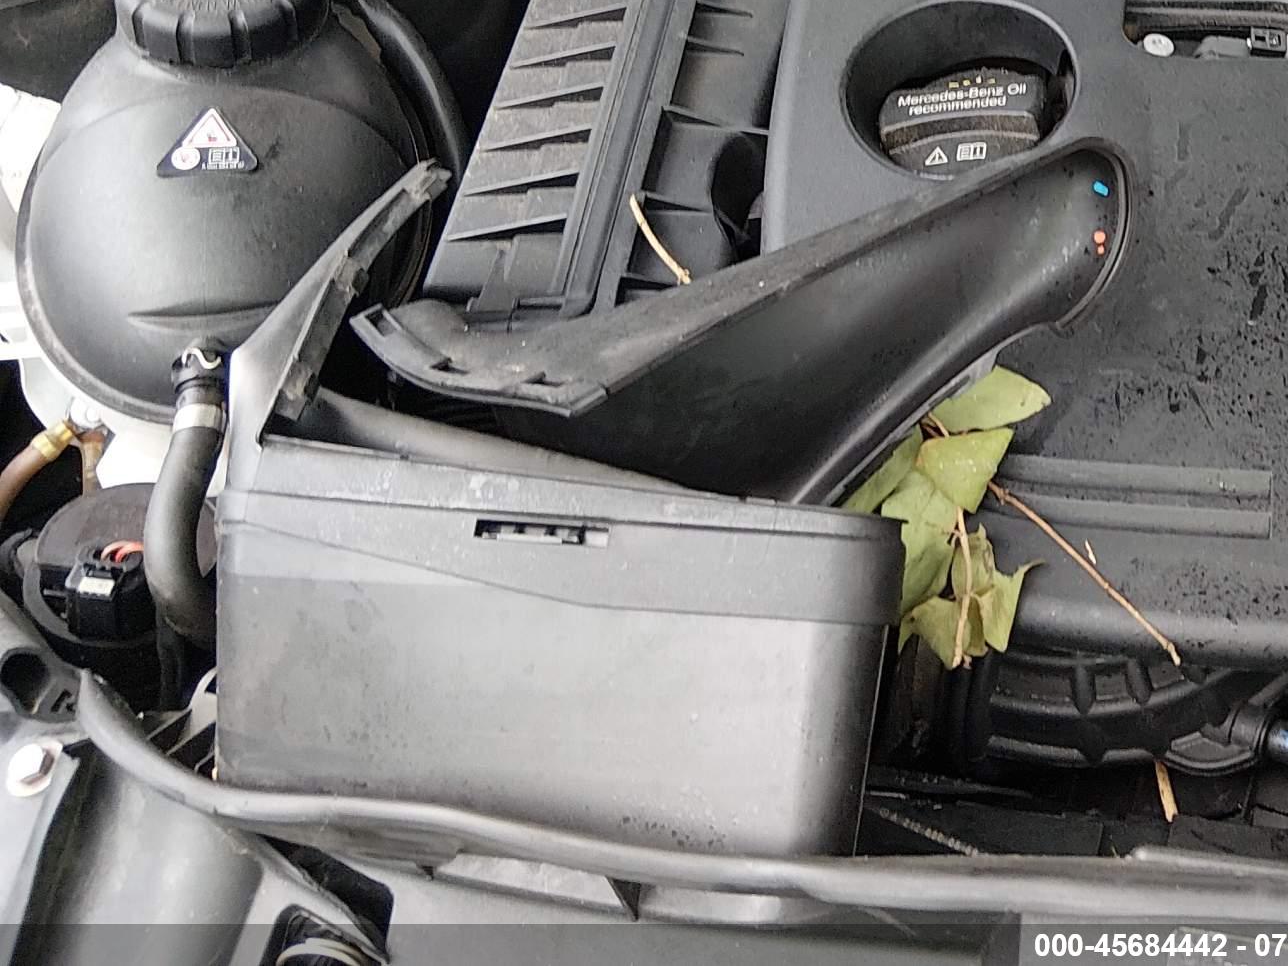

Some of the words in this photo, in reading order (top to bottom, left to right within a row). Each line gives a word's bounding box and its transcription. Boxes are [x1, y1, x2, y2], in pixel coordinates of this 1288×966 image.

[897, 86, 1004, 107] Mercedes-Benz
[1007, 83, 1026, 95] Oil
[909, 95, 1006, 116] recommended
